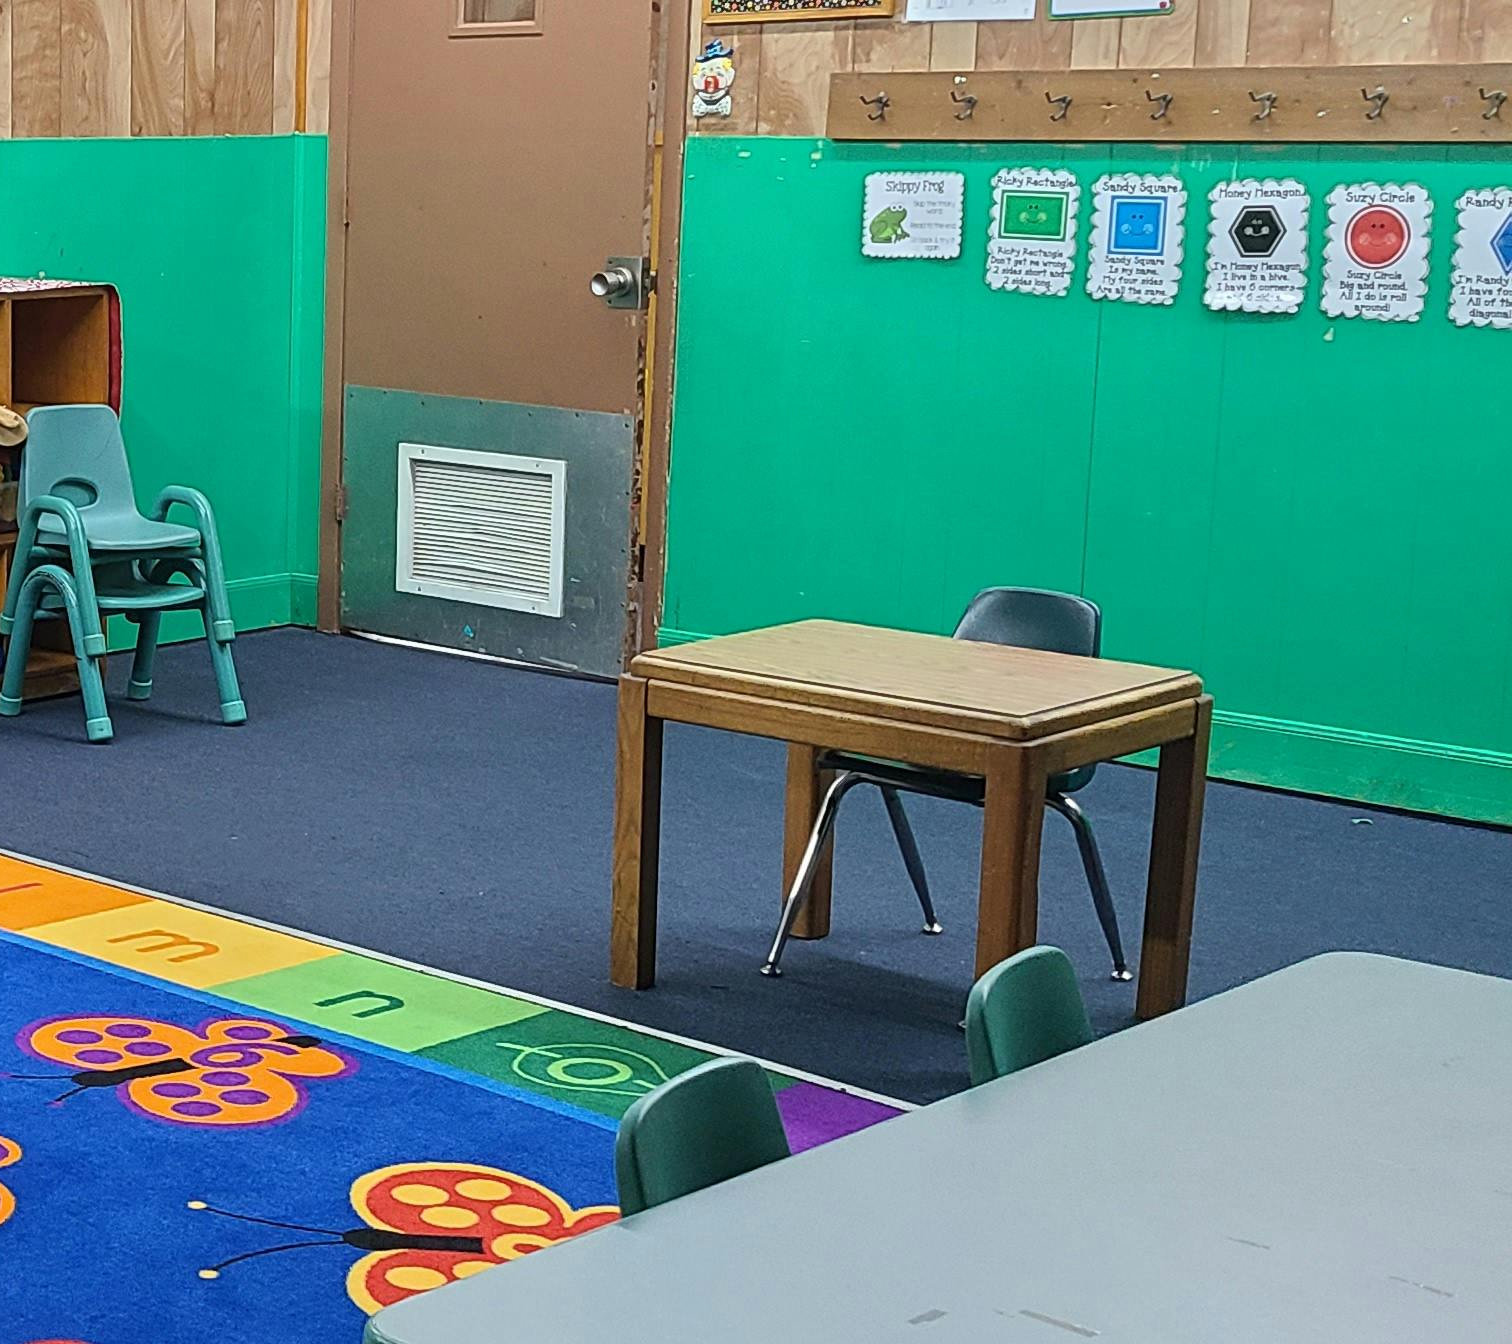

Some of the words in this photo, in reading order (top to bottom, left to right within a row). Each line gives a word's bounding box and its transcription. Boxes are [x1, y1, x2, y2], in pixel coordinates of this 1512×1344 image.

[885, 181, 921, 194] Skippy
[923, 180, 944, 194] Frog
[997, 176, 1023, 186] Ricky
[1026, 177, 1075, 189] Rectangle
[1102, 182, 1136, 194] Sandy
[1140, 183, 1178, 194] Square
[1219, 188, 1252, 200] Honey
[1255, 188, 1301, 199] Hexagon
[1346, 192, 1375, 206] Suzy
[1380, 192, 1415, 203] Circle
[1466, 197, 1504, 209] Randy
[998, 247, 1020, 257] Ricky
[1347, 270, 1370, 280] Suzy
[1374, 271, 1402, 280] Circle
[1340, 281, 1354, 291] Big
[1358, 282, 1374, 290] and
[1339, 292, 1353, 300] All
[1364, 292, 1376, 301] do
[1379, 292, 1387, 300] is
[1391, 293, 1407, 301] roll
[107, 928, 220, 962] m
[313, 990, 405, 1019] n
